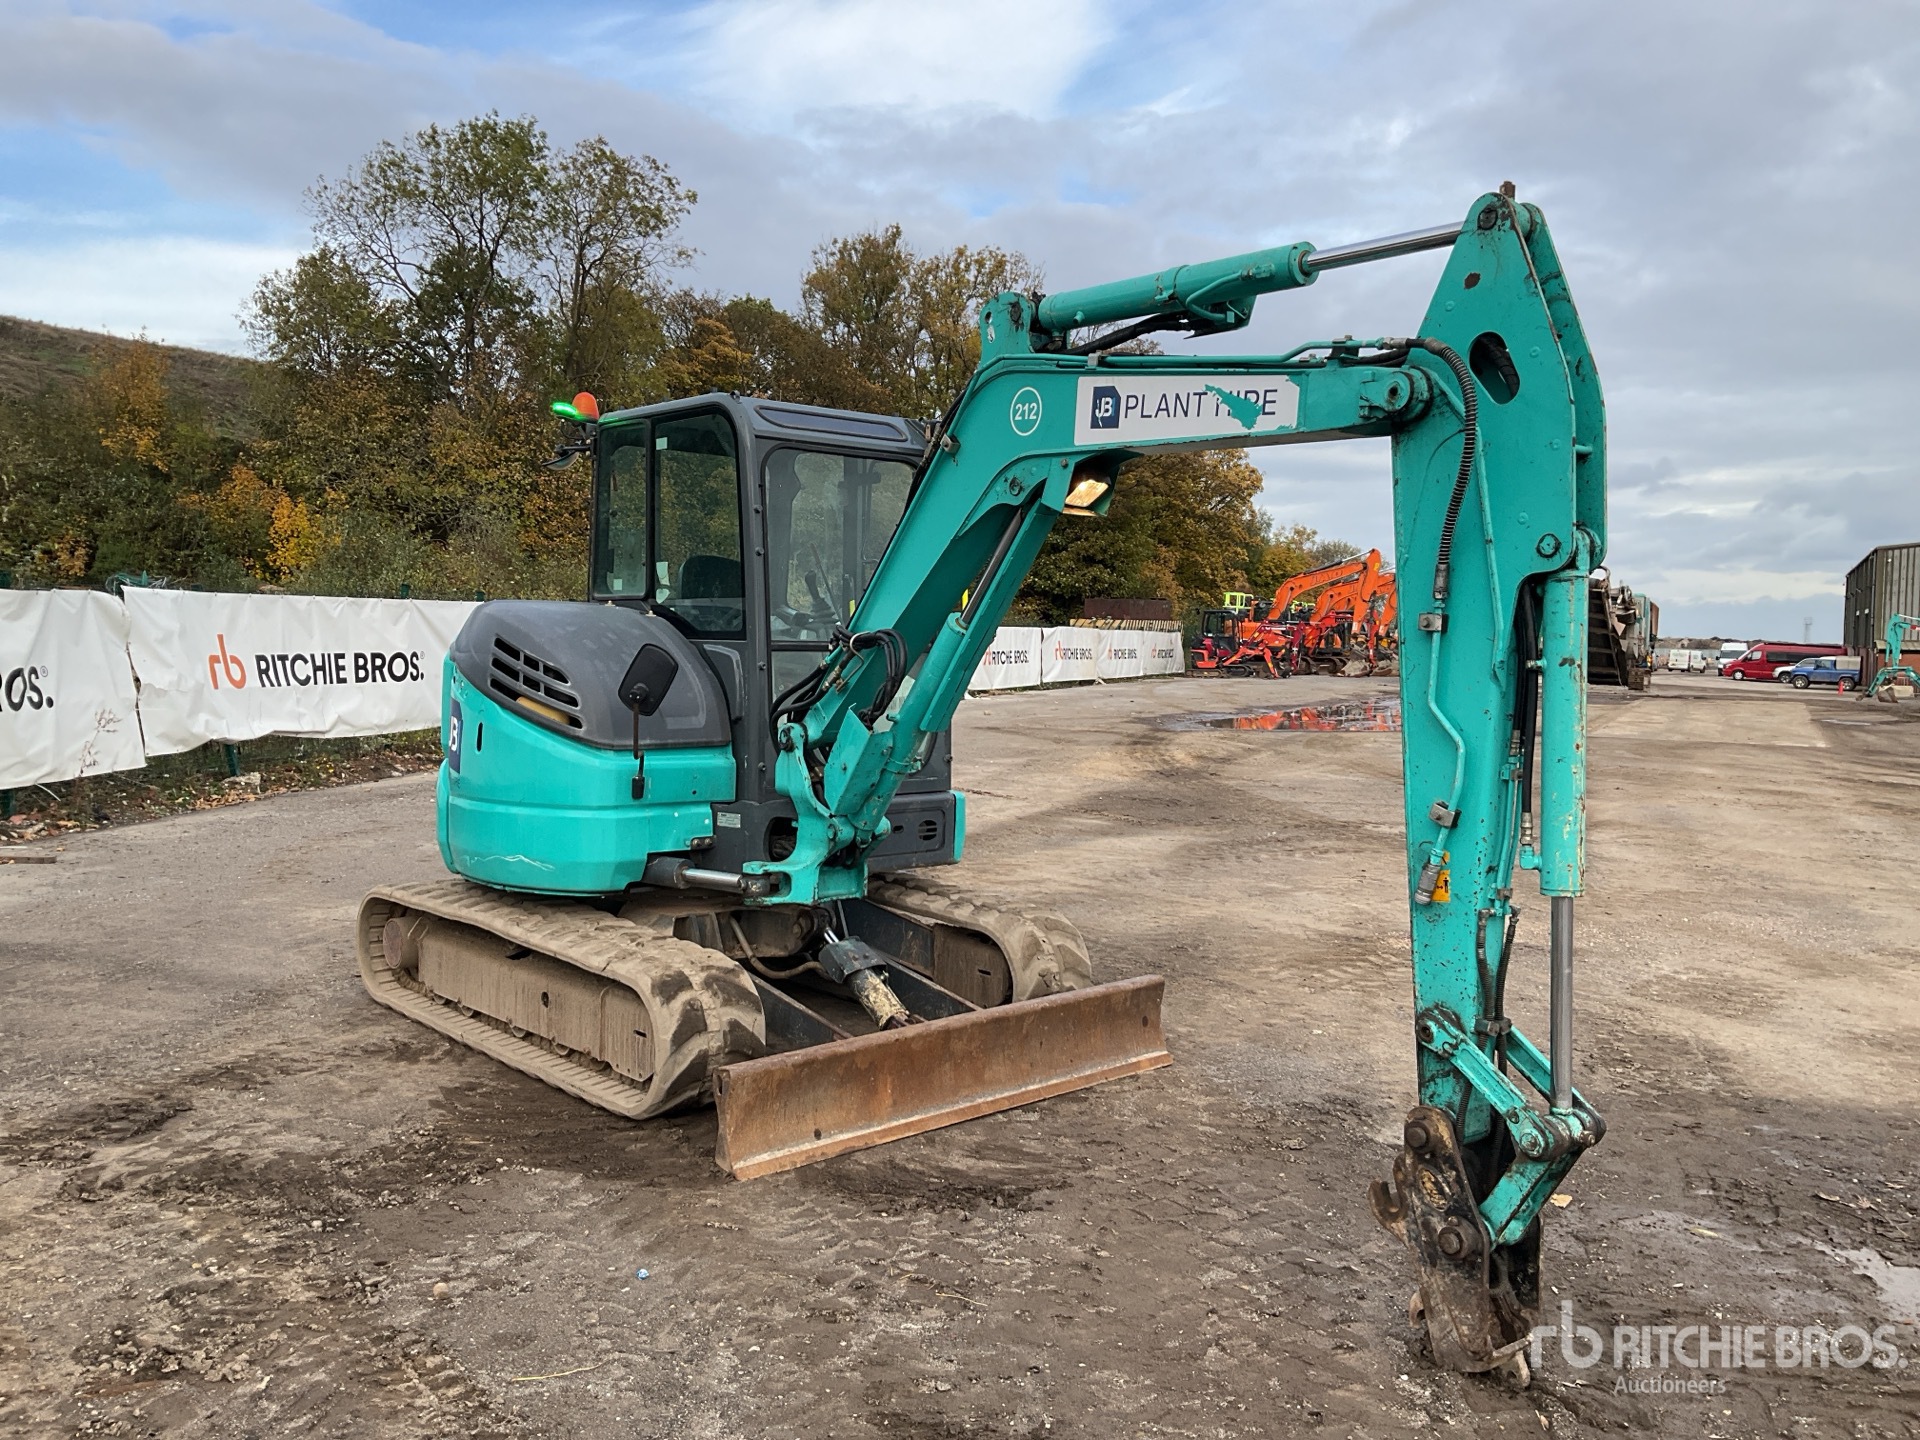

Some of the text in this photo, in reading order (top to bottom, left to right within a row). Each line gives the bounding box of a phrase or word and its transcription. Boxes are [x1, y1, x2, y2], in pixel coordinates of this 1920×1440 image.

[1015, 402, 1037, 421] 212
[1124, 391, 1208, 419] PLANT
[254, 653, 348, 688] RITCHIE
[353, 651, 425, 684] BROS.
[0, 665, 54, 712] OS.
